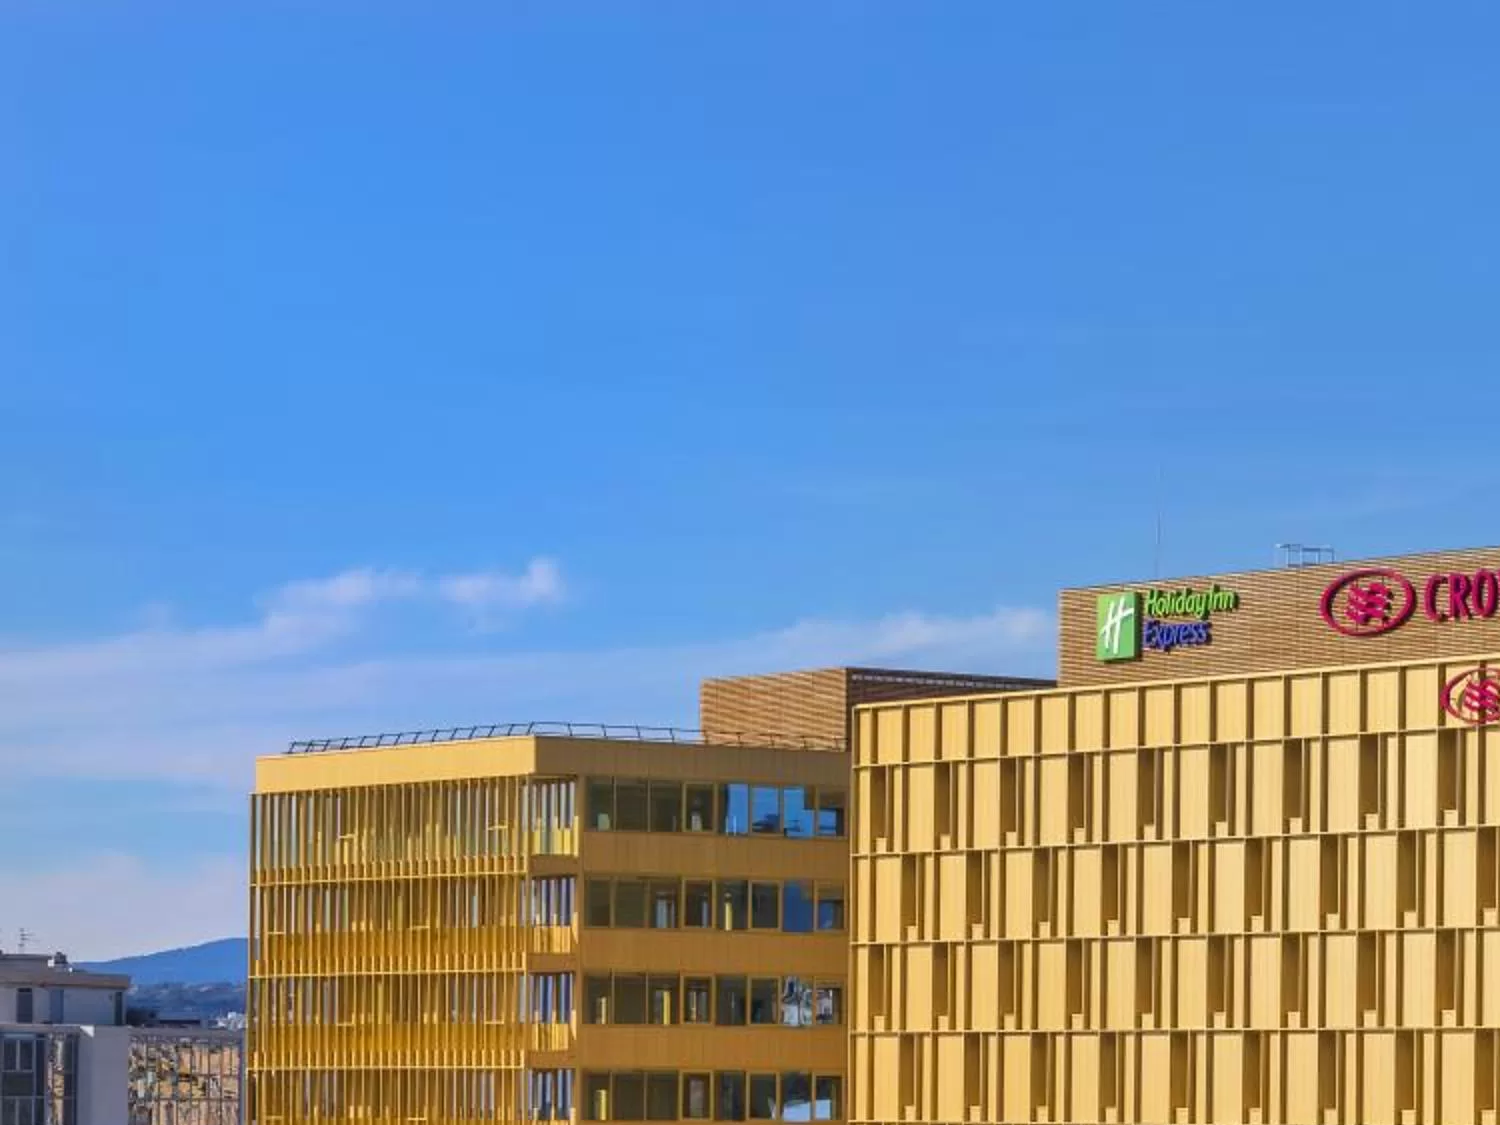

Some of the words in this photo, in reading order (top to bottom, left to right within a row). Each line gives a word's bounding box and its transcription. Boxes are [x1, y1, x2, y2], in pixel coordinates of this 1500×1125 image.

[1144, 586, 1206, 619] Holiday
[1208, 582, 1237, 611] Inn
[1142, 619, 1212, 651] Express
